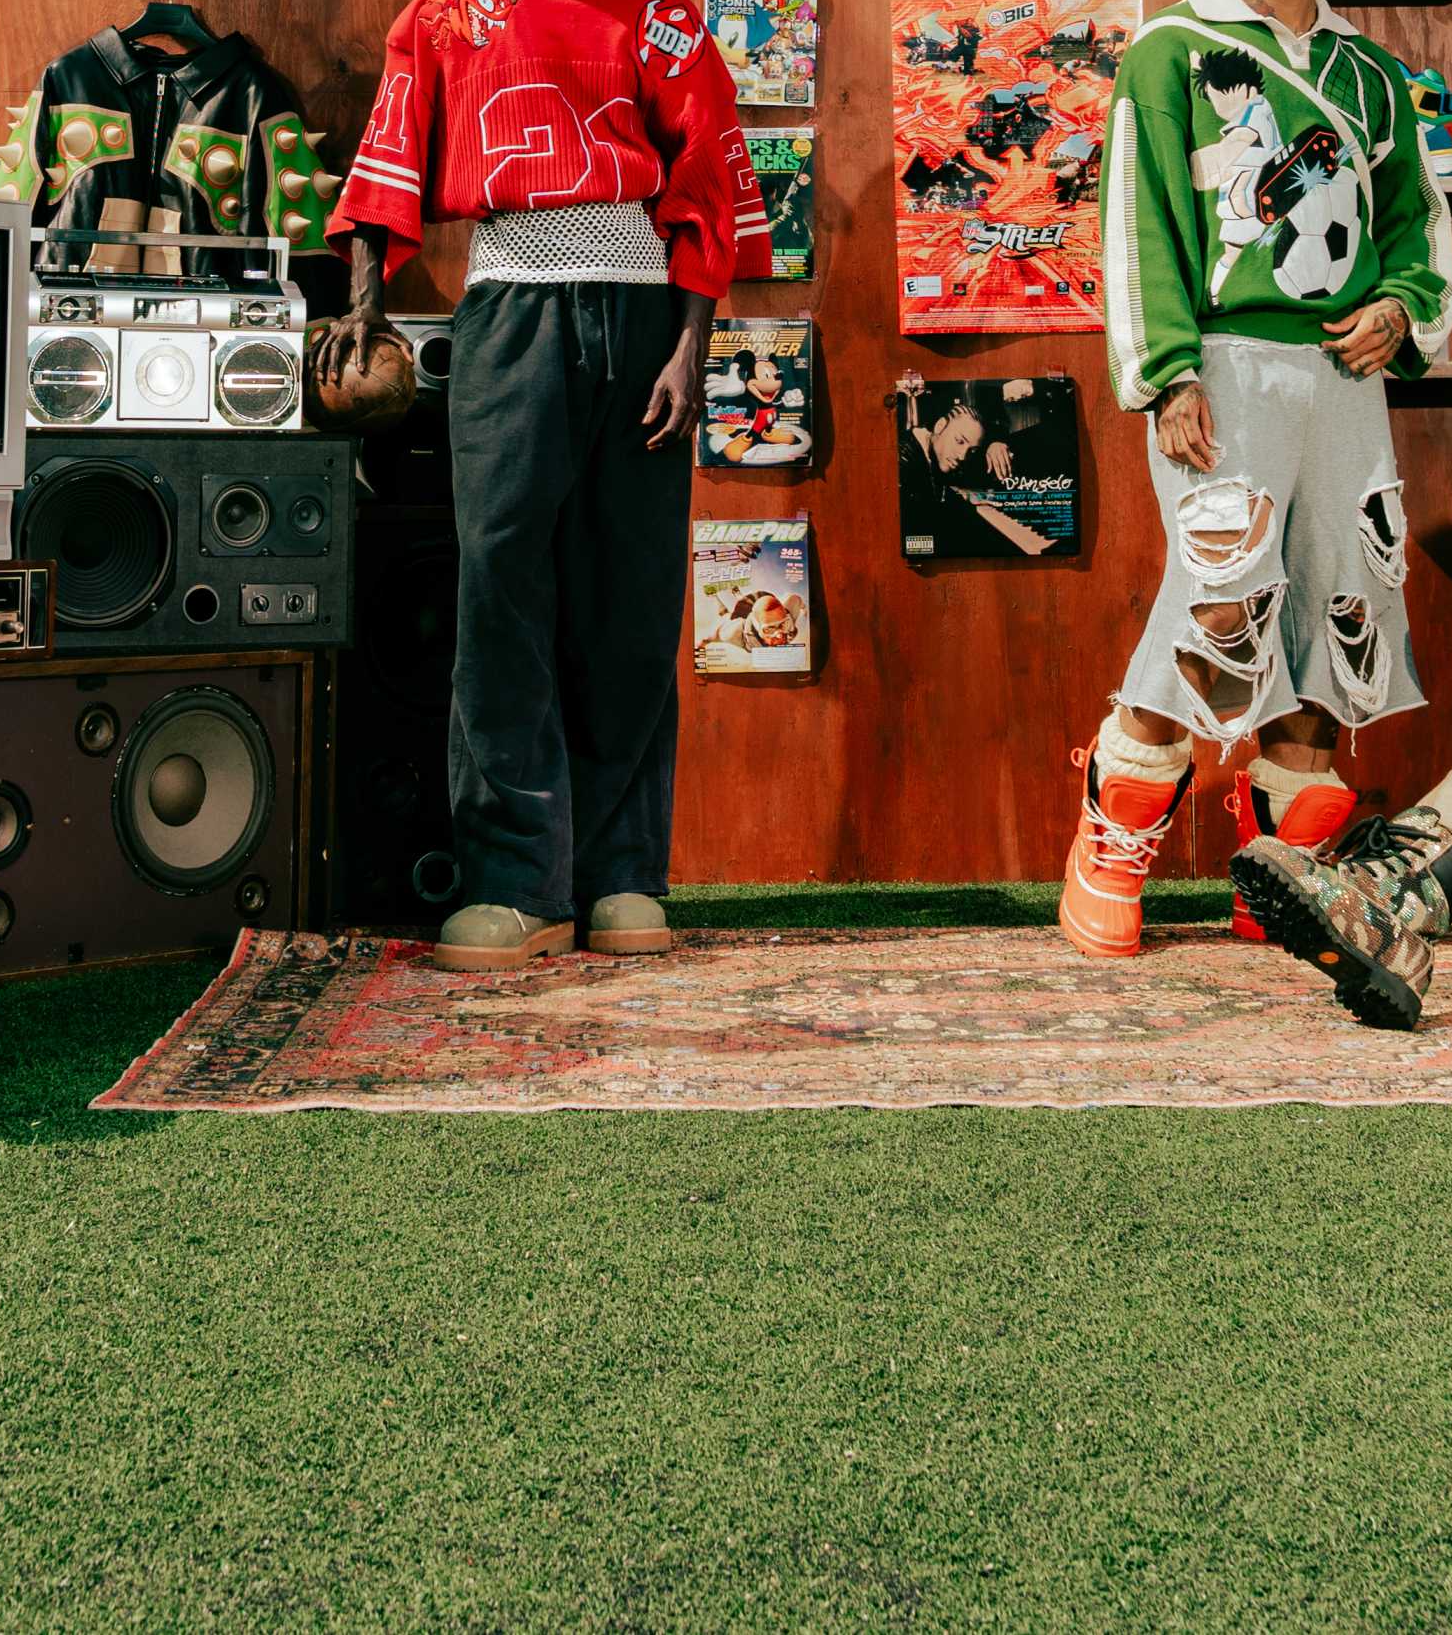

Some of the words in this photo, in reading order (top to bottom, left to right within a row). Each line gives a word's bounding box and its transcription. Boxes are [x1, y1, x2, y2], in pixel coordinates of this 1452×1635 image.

[1004, 3, 1035, 24] BIG
[748, 138, 773, 156] PS
[753, 155, 801, 170] ICKS
[906, 281, 916, 293] E
[710, 331, 778, 342] NINTENDO
[740, 343, 802, 356] POWER
[1001, 474, 1074, 494] D'Angelo
